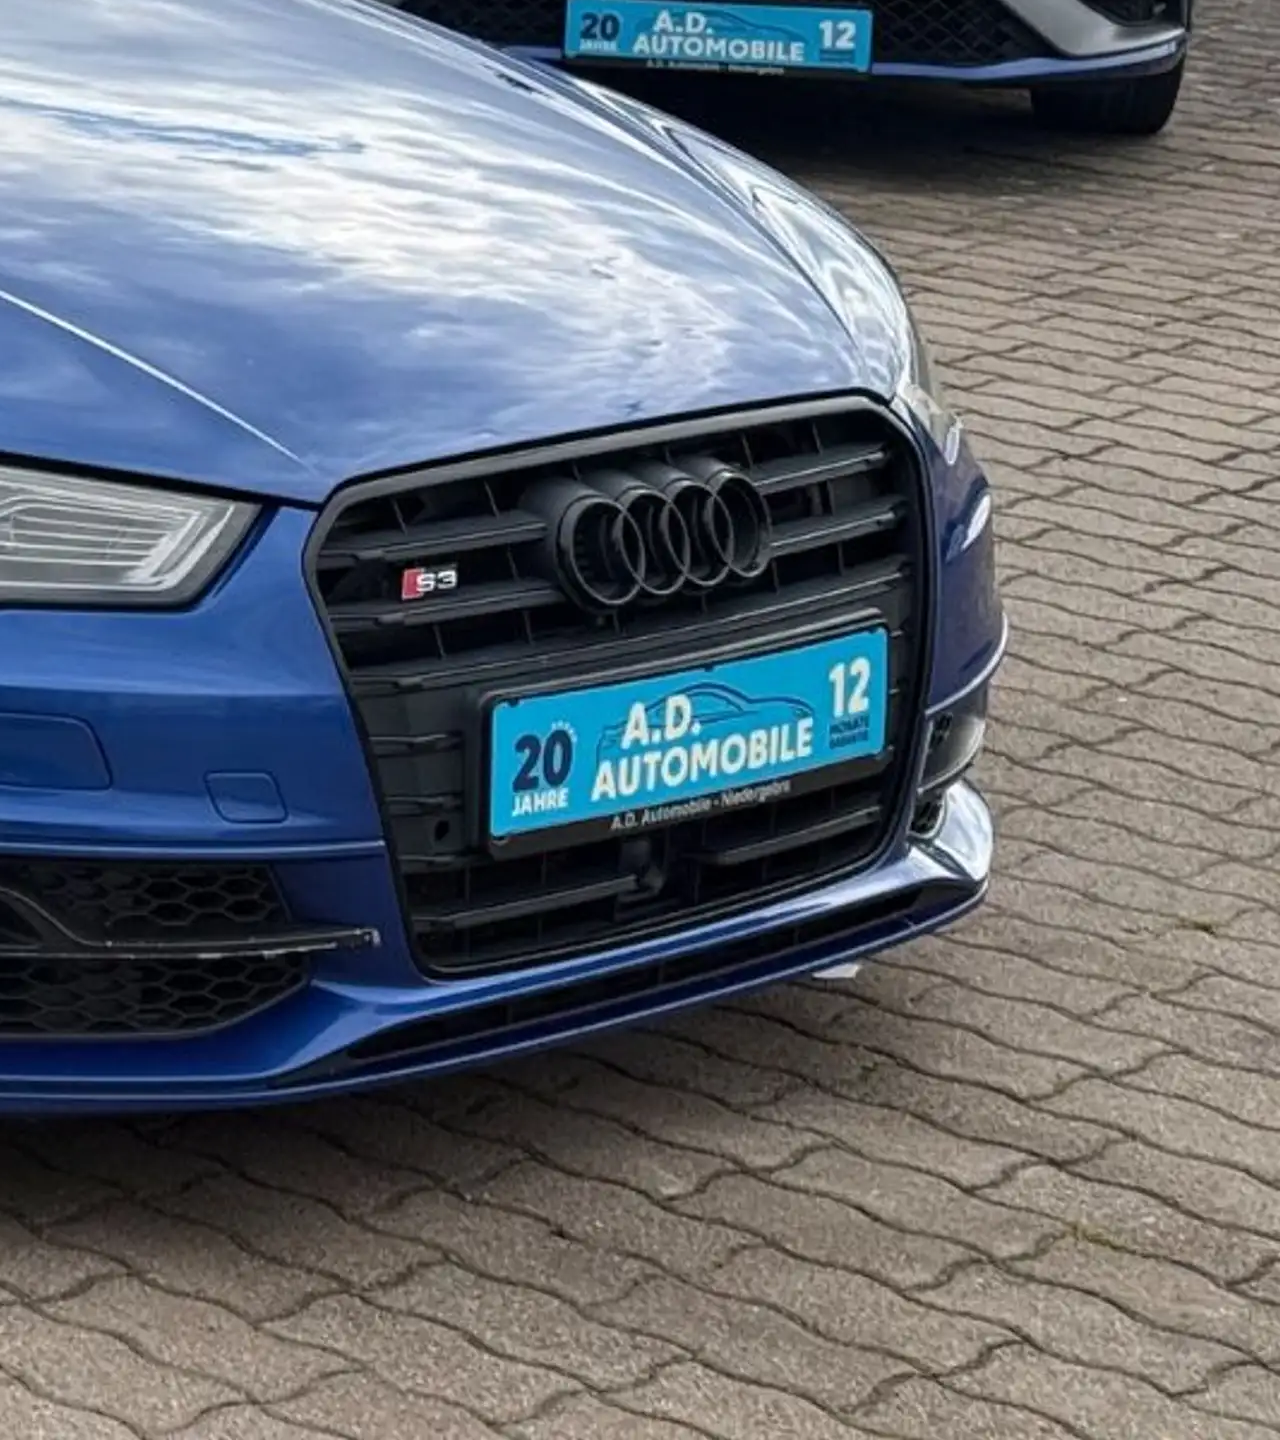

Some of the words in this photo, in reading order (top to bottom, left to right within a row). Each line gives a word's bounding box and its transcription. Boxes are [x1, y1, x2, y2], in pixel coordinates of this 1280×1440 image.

[580, 12, 620, 43] 20
[653, 10, 713, 35] A.D.
[819, 20, 856, 49] 12
[633, 35, 804, 61] AUTOMOBILE
[416, 569, 457, 593] S3
[513, 733, 573, 793] 20
[621, 695, 701, 749] A.D.
[829, 657, 870, 717] 12
[512, 787, 569, 817] JAHRE
[591, 717, 814, 802] AUTOMOBILE
